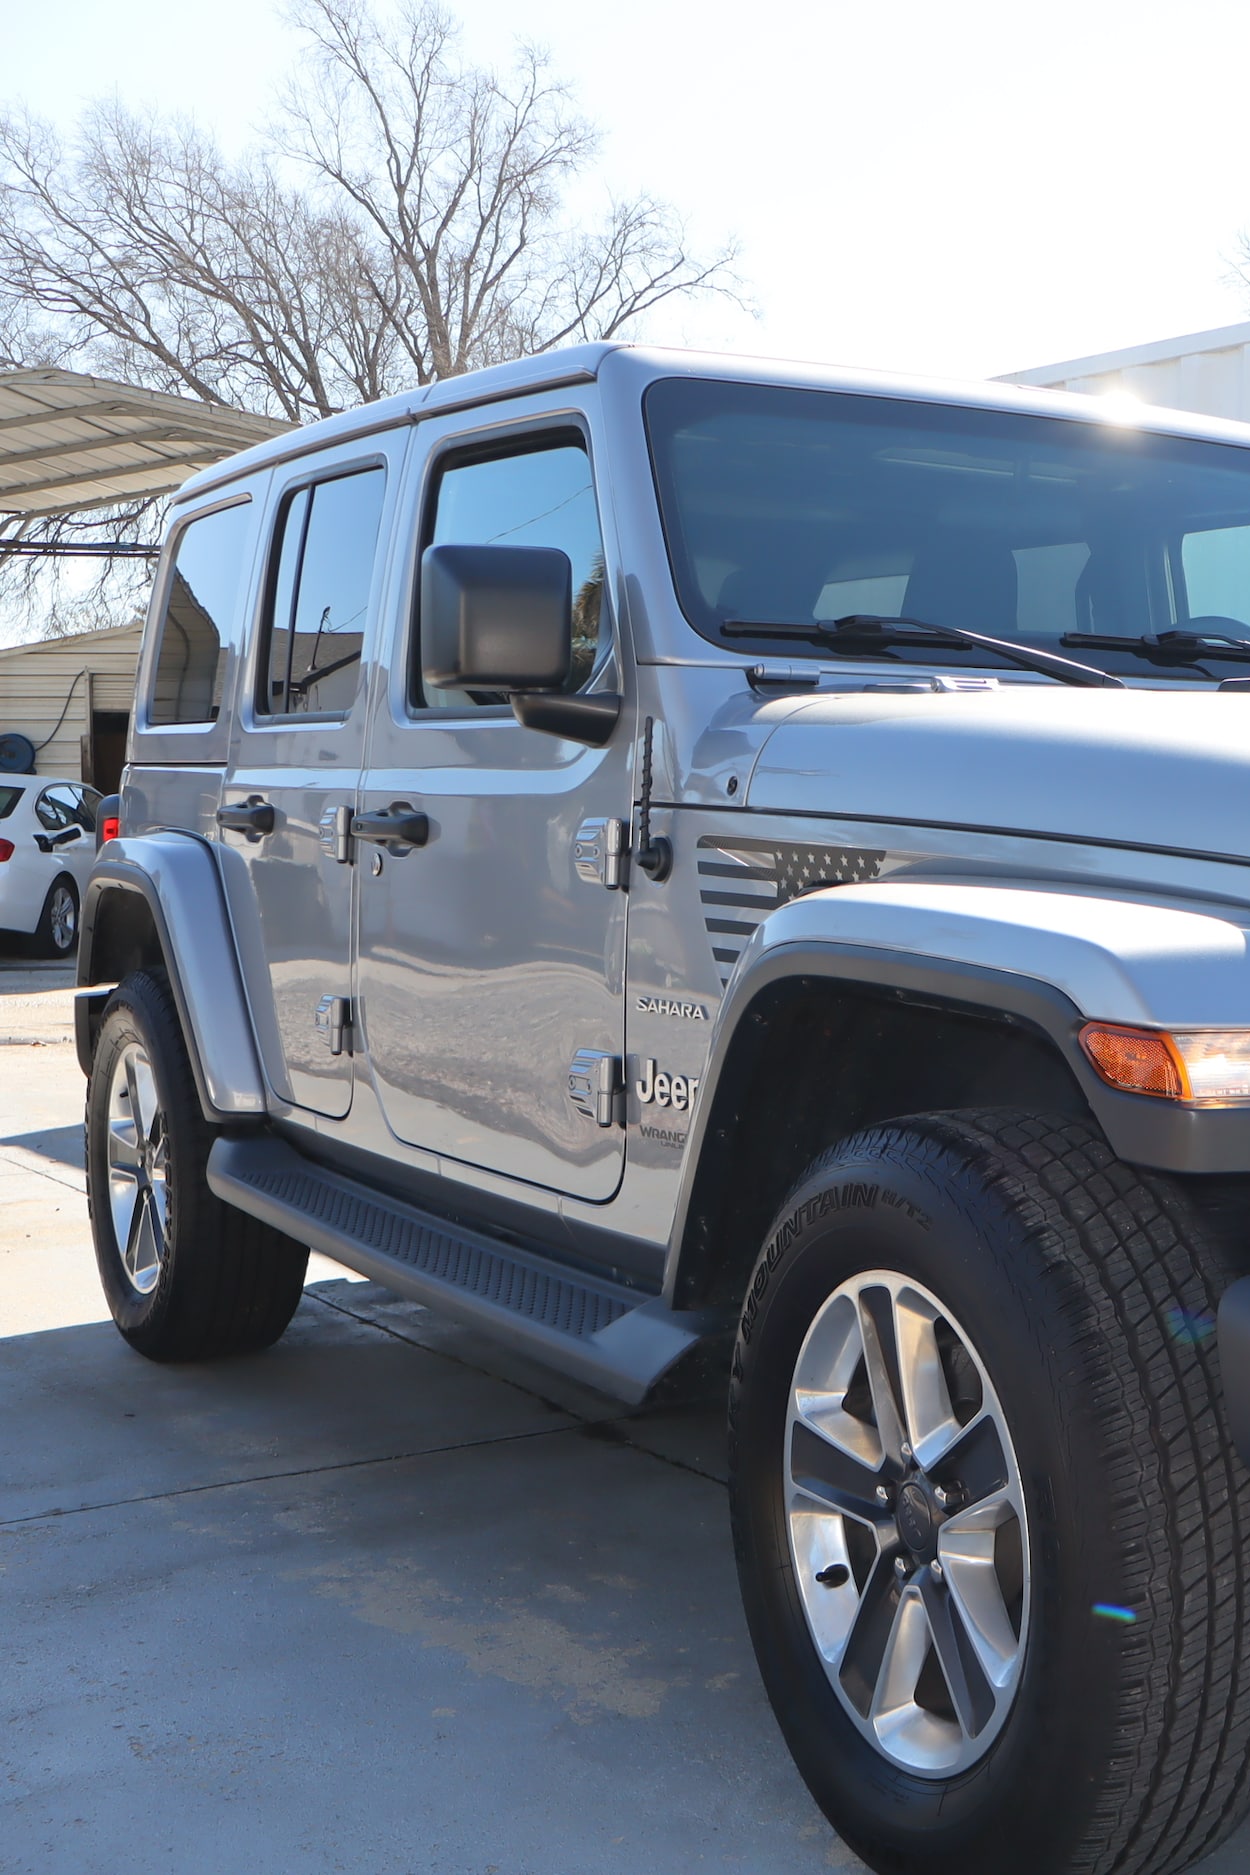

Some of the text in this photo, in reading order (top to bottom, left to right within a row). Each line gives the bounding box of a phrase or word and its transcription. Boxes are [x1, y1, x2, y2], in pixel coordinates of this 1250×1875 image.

[636, 997, 707, 1020] SAHARA
[640, 1126, 688, 1144] WRANG
[741, 1183, 879, 1344] MOUNTAIN
